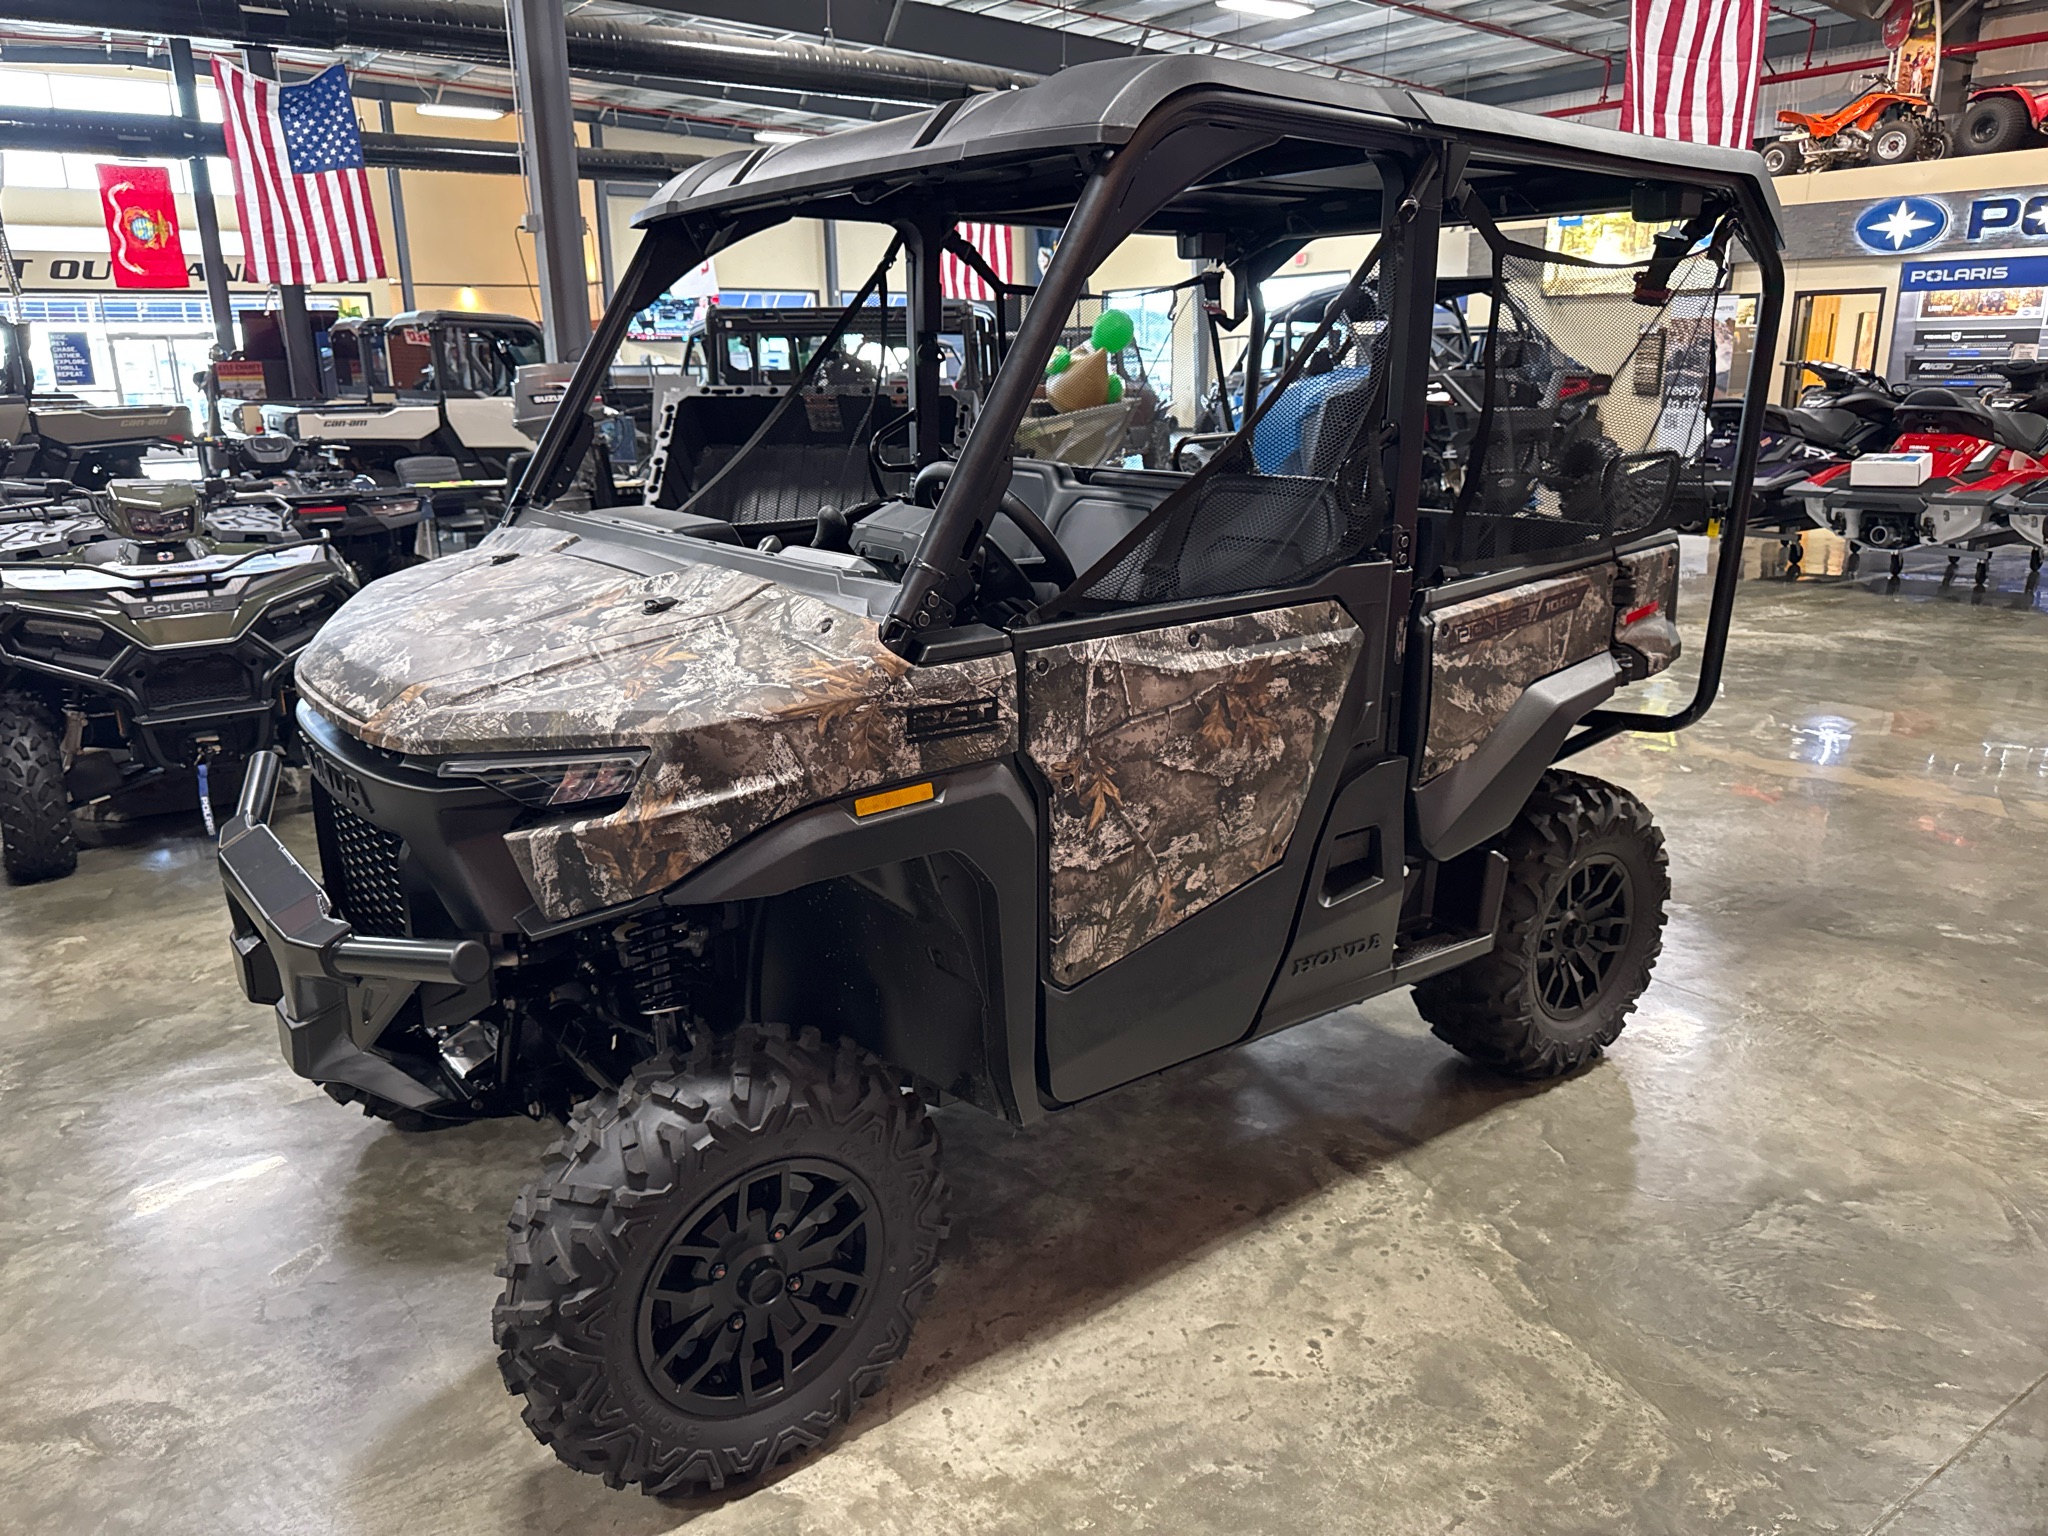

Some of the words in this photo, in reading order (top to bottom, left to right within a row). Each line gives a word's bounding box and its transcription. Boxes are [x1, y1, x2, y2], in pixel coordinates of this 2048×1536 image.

[1910, 266, 2008, 283] POLARIS
[1919, 362, 1954, 370] RIGID
[533, 395, 564, 403] SUZU
[120, 418, 168, 427] can-am
[1803, 445, 1837, 460] FX
[142, 599, 224, 615] POLARIS
[1291, 933, 1383, 976] HONDA
